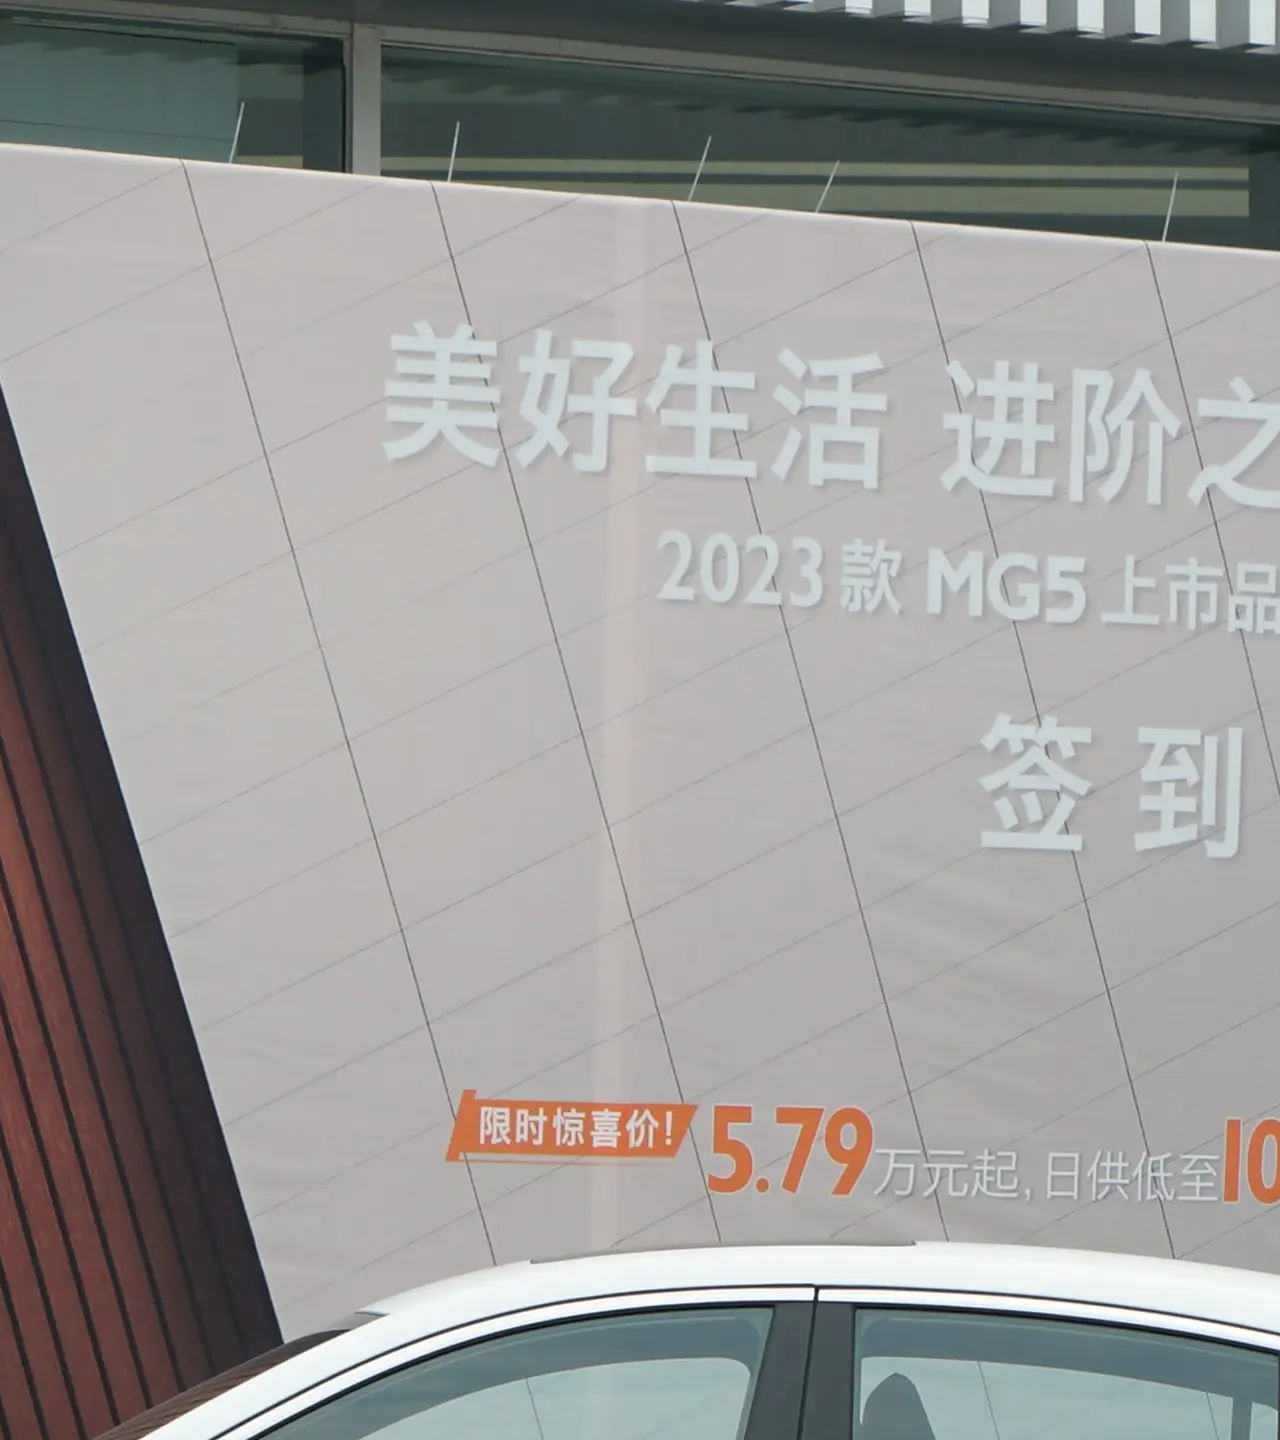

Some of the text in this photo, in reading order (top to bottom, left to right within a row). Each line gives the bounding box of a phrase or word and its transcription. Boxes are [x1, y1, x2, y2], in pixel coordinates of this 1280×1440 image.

[381, 320, 888, 490] 美好生活
[926, 547, 1088, 624] MG5
[478, 1105, 674, 1150] 限时惊喜价!
